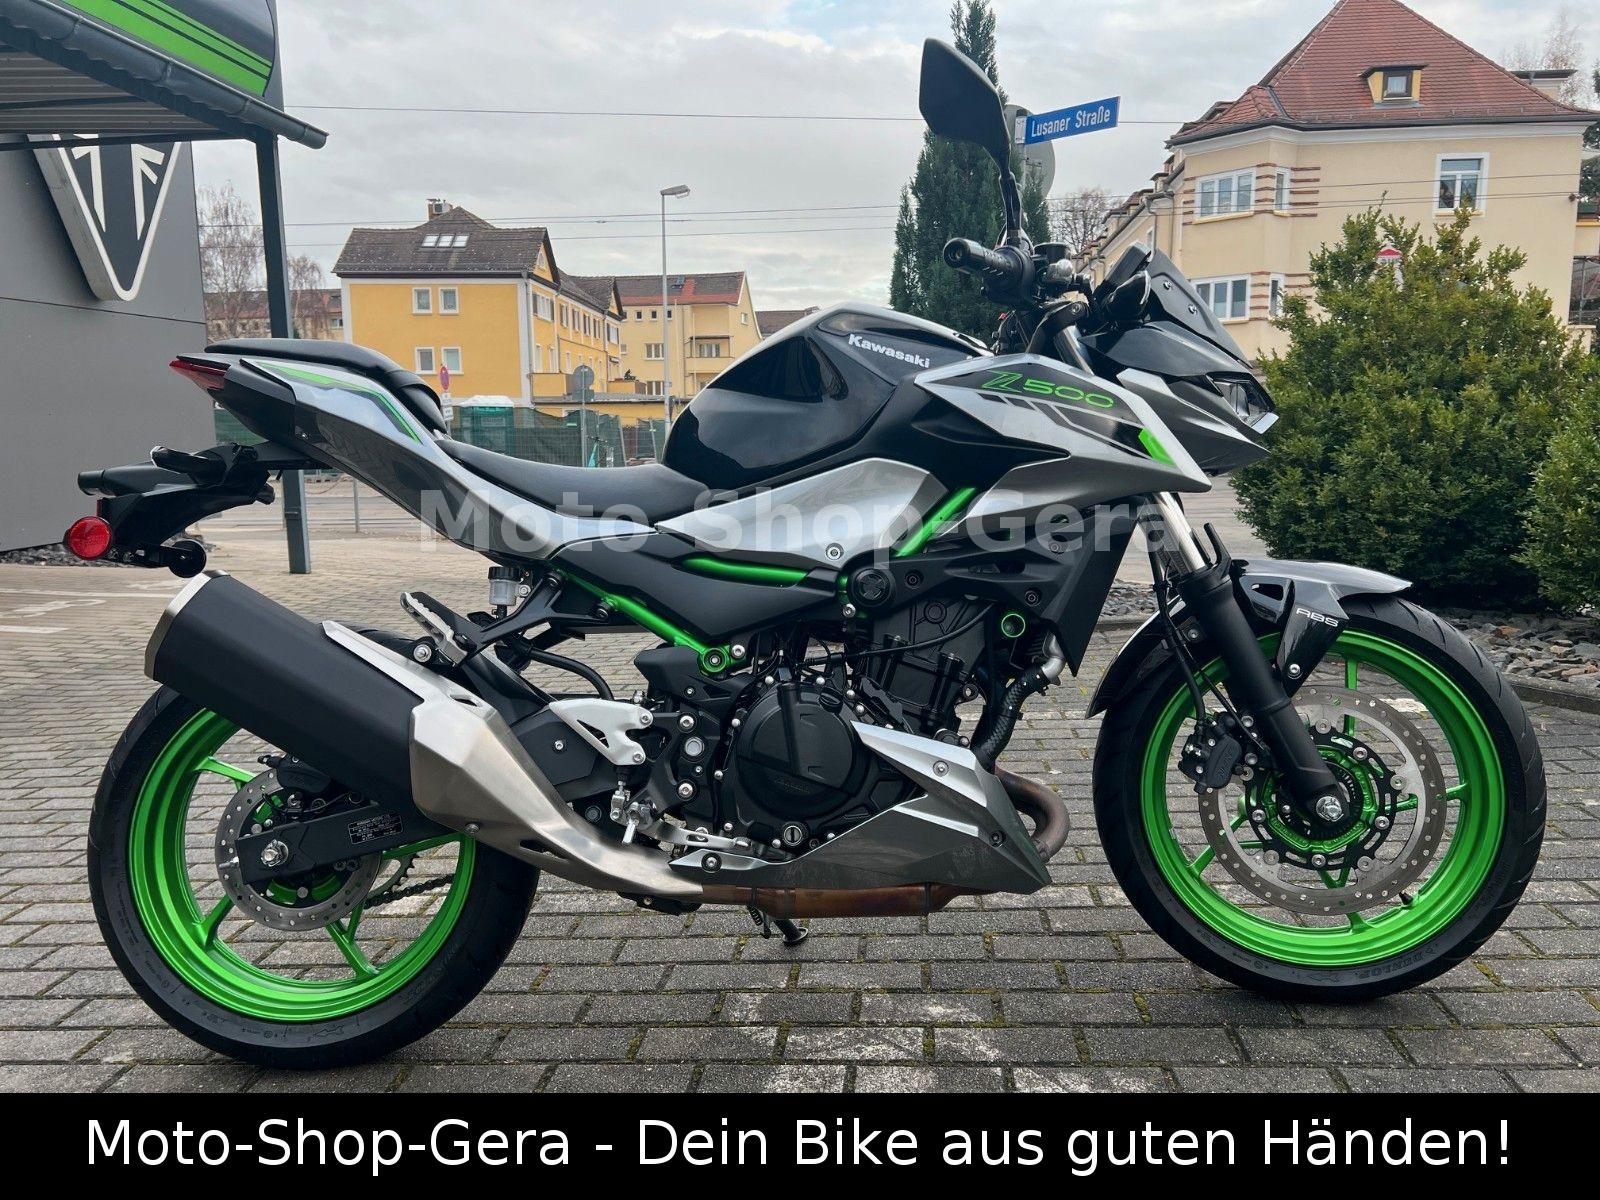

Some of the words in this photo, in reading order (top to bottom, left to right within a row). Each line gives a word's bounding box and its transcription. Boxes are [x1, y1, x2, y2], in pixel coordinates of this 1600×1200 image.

[1031, 117, 1070, 138] Lusaner
[1075, 105, 1110, 129] Straße
[848, 332, 931, 369] Kawasaki
[1295, 607, 1339, 628] ABS
